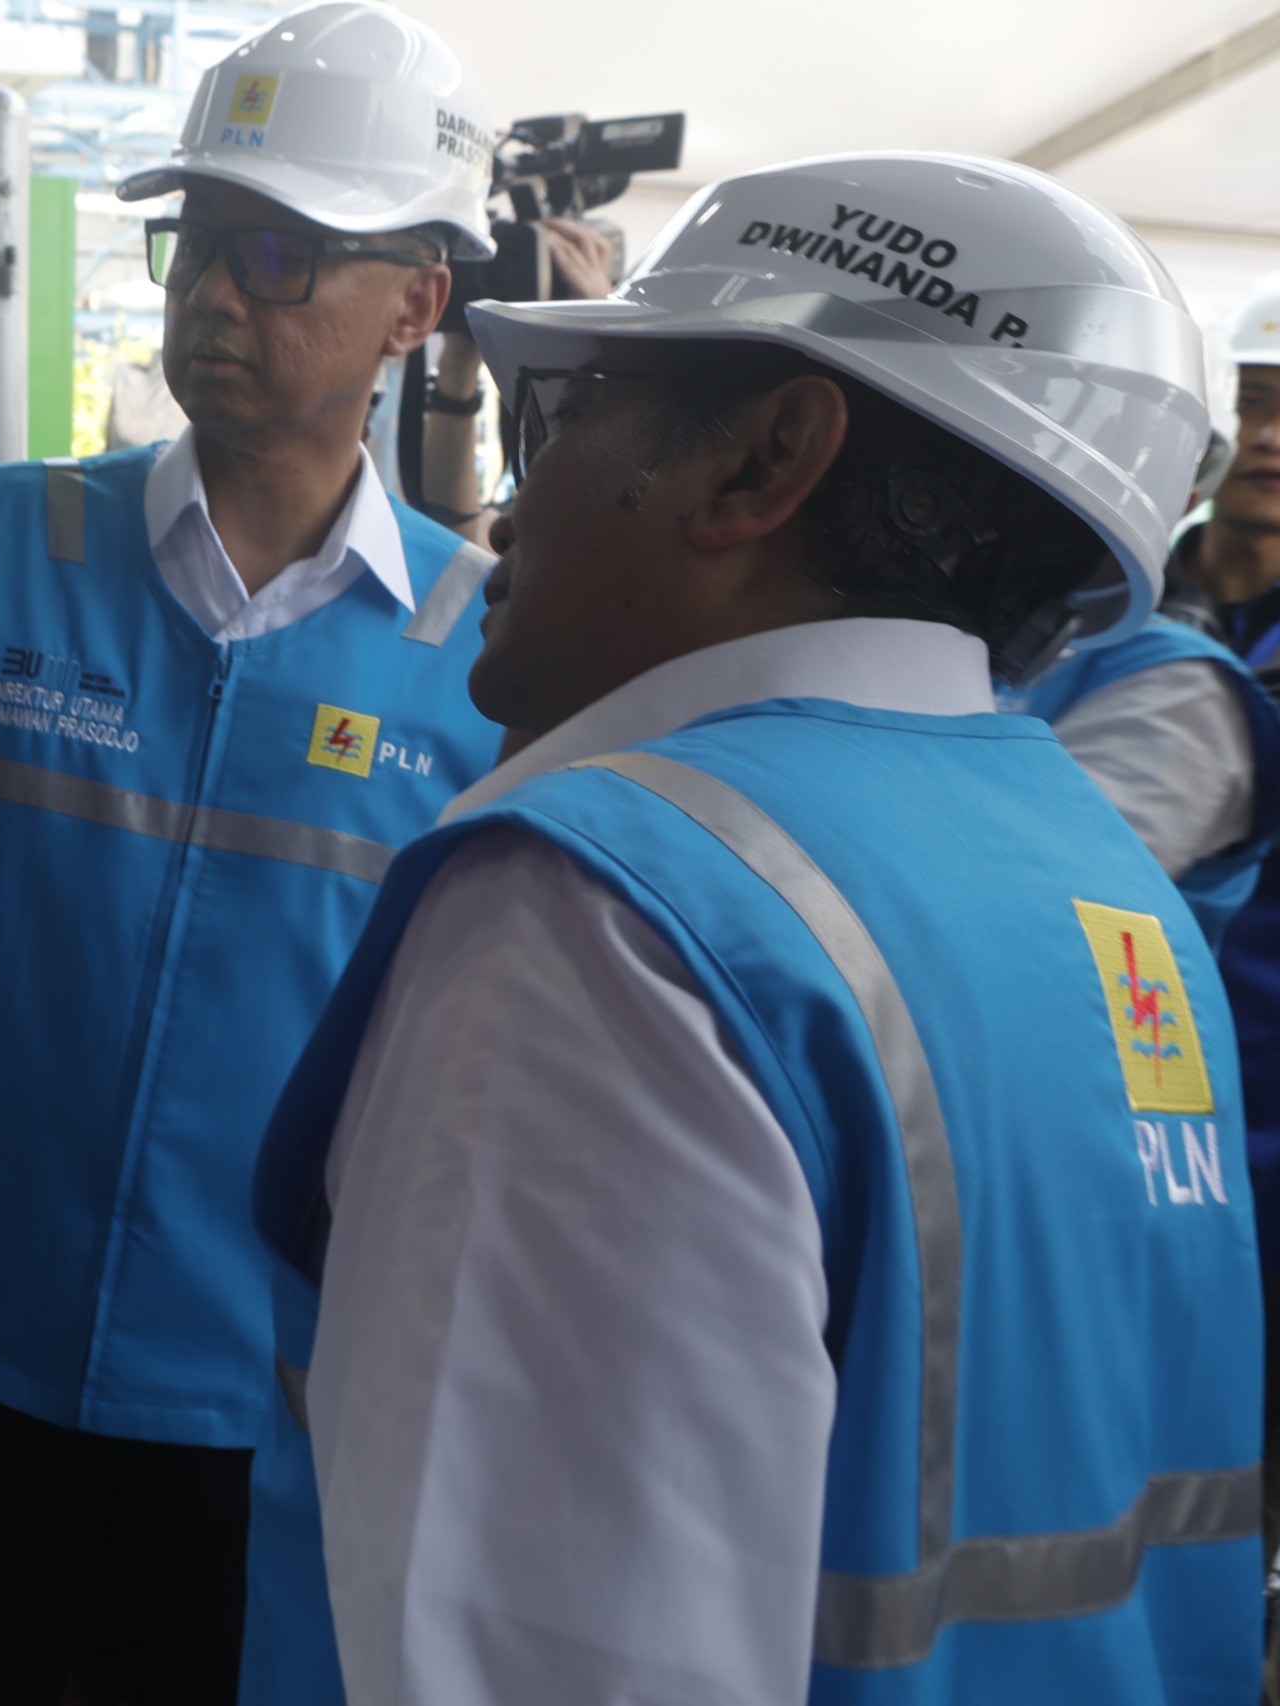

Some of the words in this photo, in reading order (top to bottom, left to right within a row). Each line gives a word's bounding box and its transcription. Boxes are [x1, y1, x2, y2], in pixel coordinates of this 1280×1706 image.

[221, 127, 265, 148] PLN
[830, 203, 958, 269] YUDO
[737, 220, 981, 328] DWINANDA
[70, 695, 124, 727] UTAMA
[54, 713, 140, 753] PRASODJO
[378, 740, 433, 777] PLN
[1133, 1118, 1229, 1207] PLN
